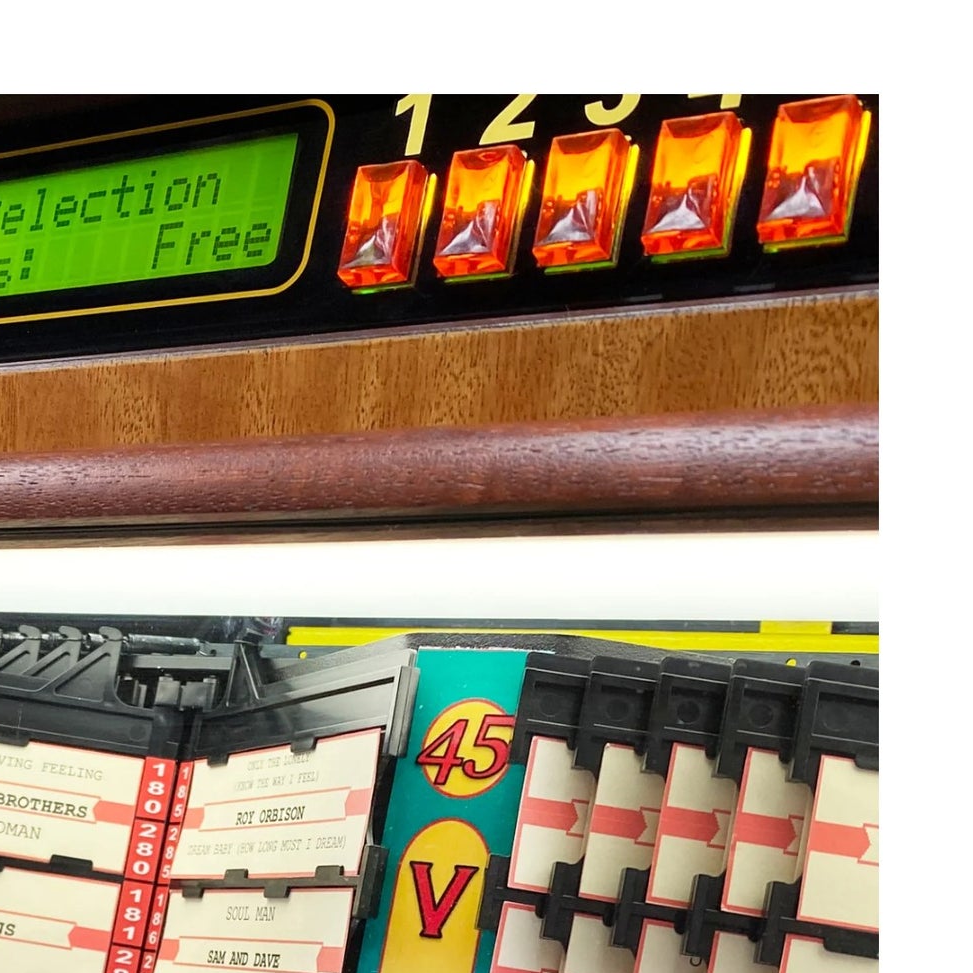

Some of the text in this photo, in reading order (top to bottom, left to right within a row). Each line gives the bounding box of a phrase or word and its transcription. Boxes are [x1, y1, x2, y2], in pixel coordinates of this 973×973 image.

[395, 94, 538, 156] 1 2
[151, 217, 273, 270] Free
[416, 714, 515, 786] 45
[41, 759, 104, 781] FEELING
[235, 805, 306, 826] ROY ORBISON
[226, 905, 276, 922] SOUL MAN
[207, 950, 281, 968] SAM AND DAVE
